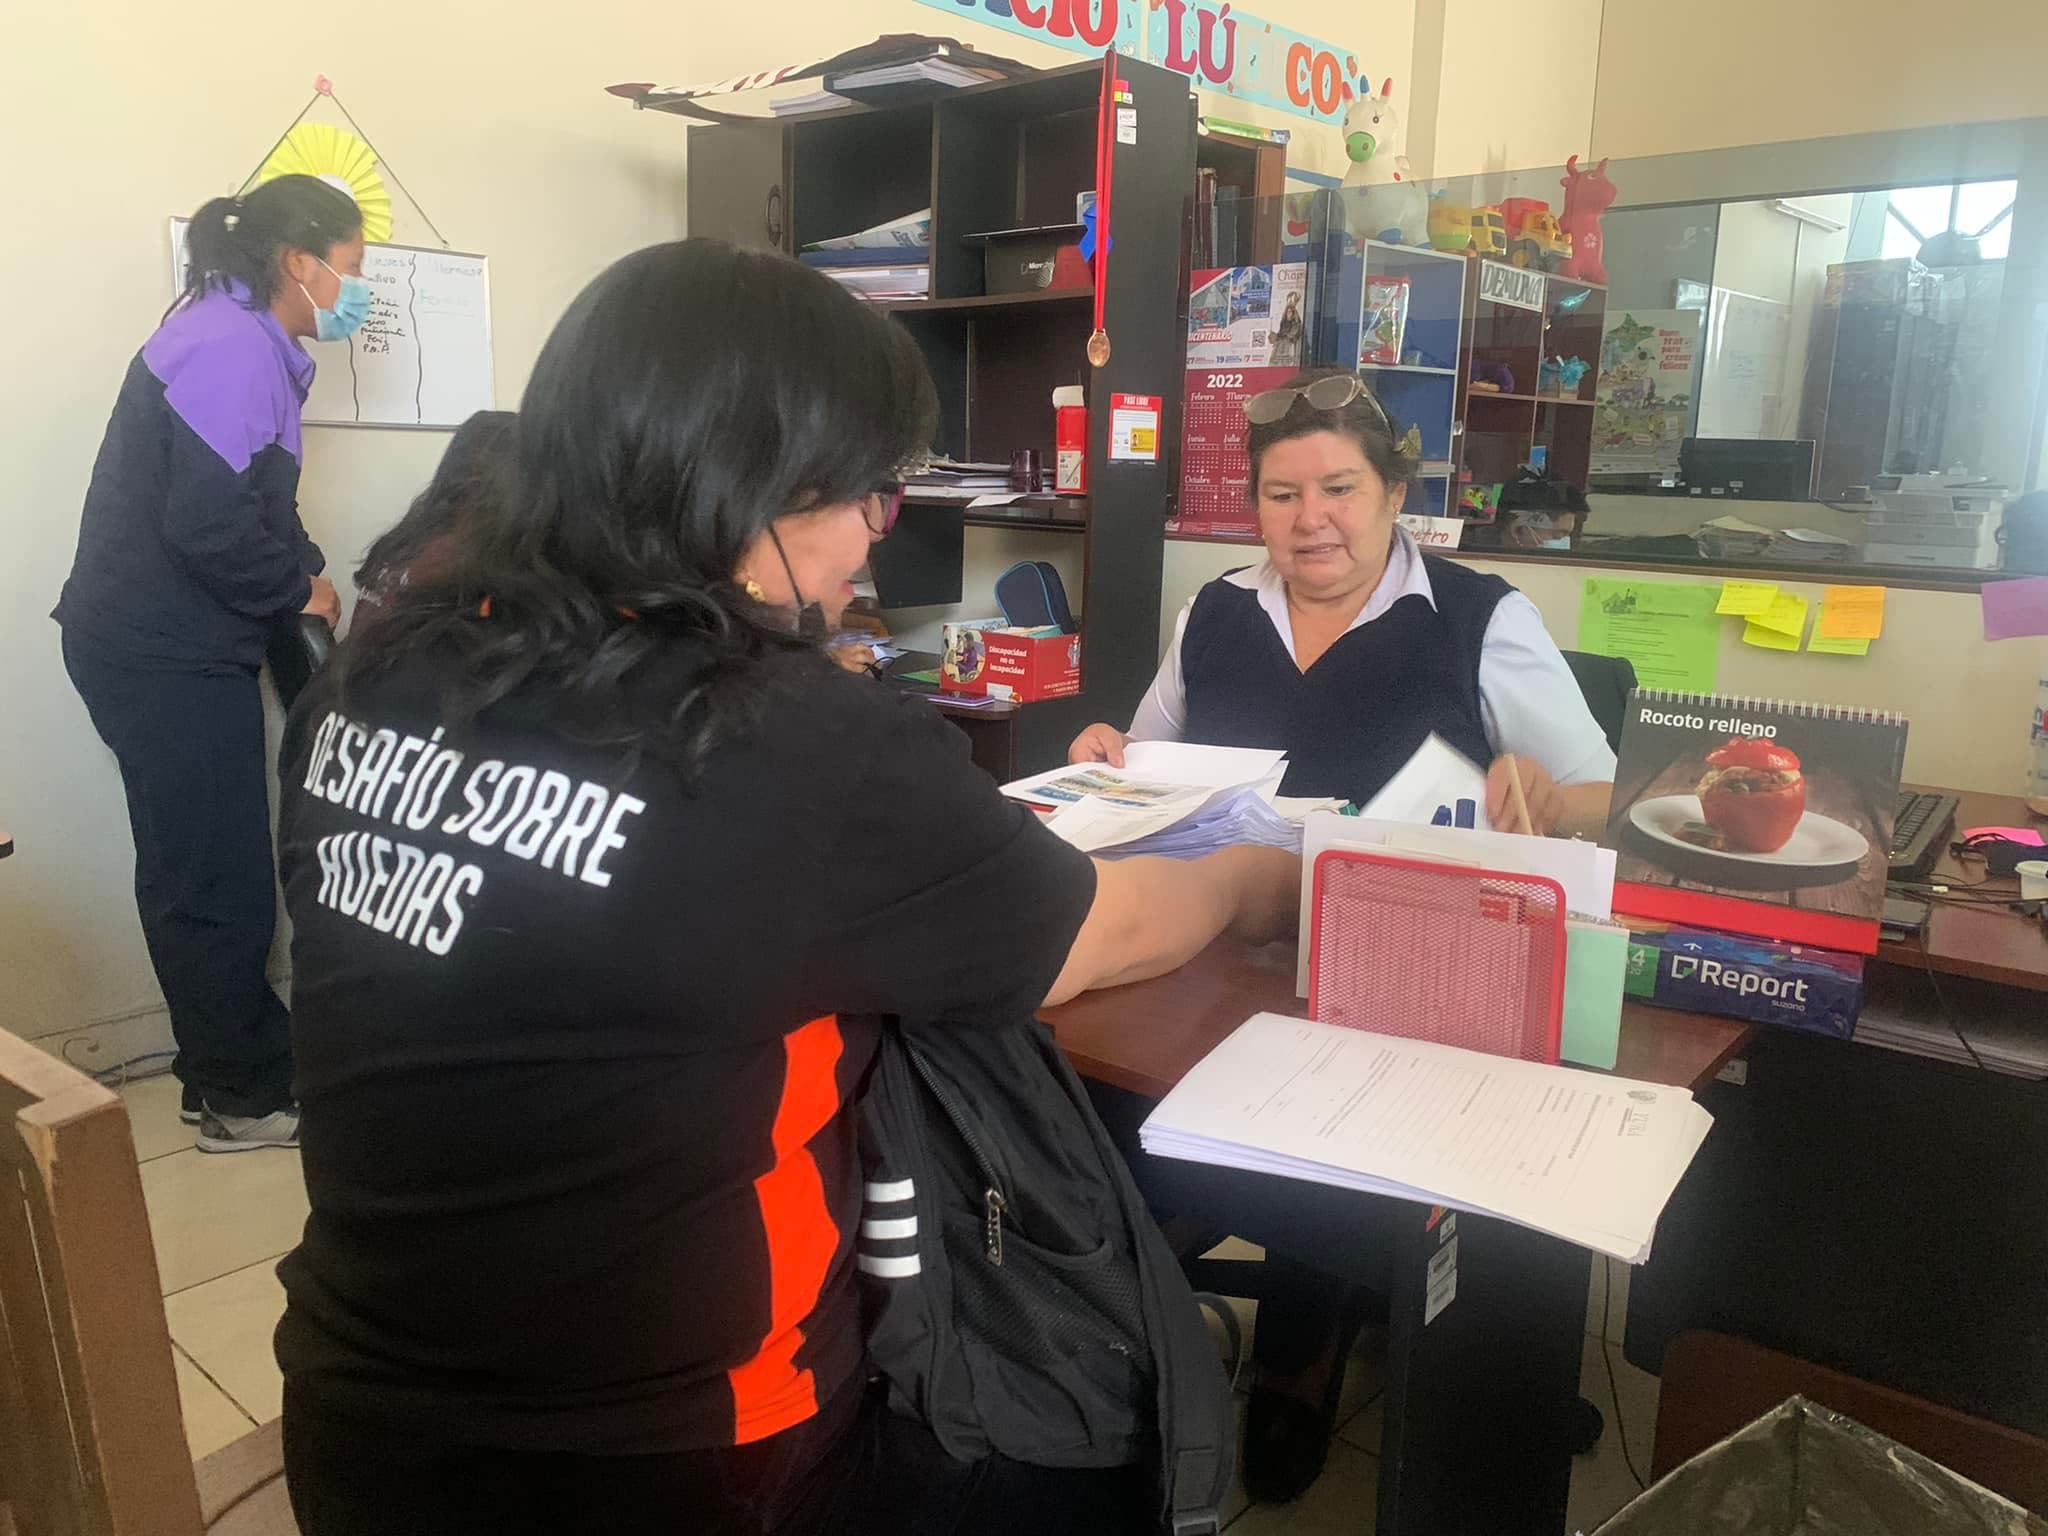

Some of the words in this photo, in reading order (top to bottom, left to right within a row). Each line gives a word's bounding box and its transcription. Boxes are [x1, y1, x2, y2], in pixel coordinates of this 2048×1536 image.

[1207, 374, 1243, 388] 2022
[1191, 392, 1215, 401] Febrero
[989, 646, 1027, 657] Discapacidad
[989, 662, 1025, 675] Incapacidad
[1639, 708, 1704, 731] Rocoto
[1708, 717, 1777, 738] relleno
[303, 711, 465, 831] DESAFÍO
[441, 760, 647, 888] SOBRE
[1700, 959, 1809, 1003] Report
[1771, 999, 1806, 1012] suzano
